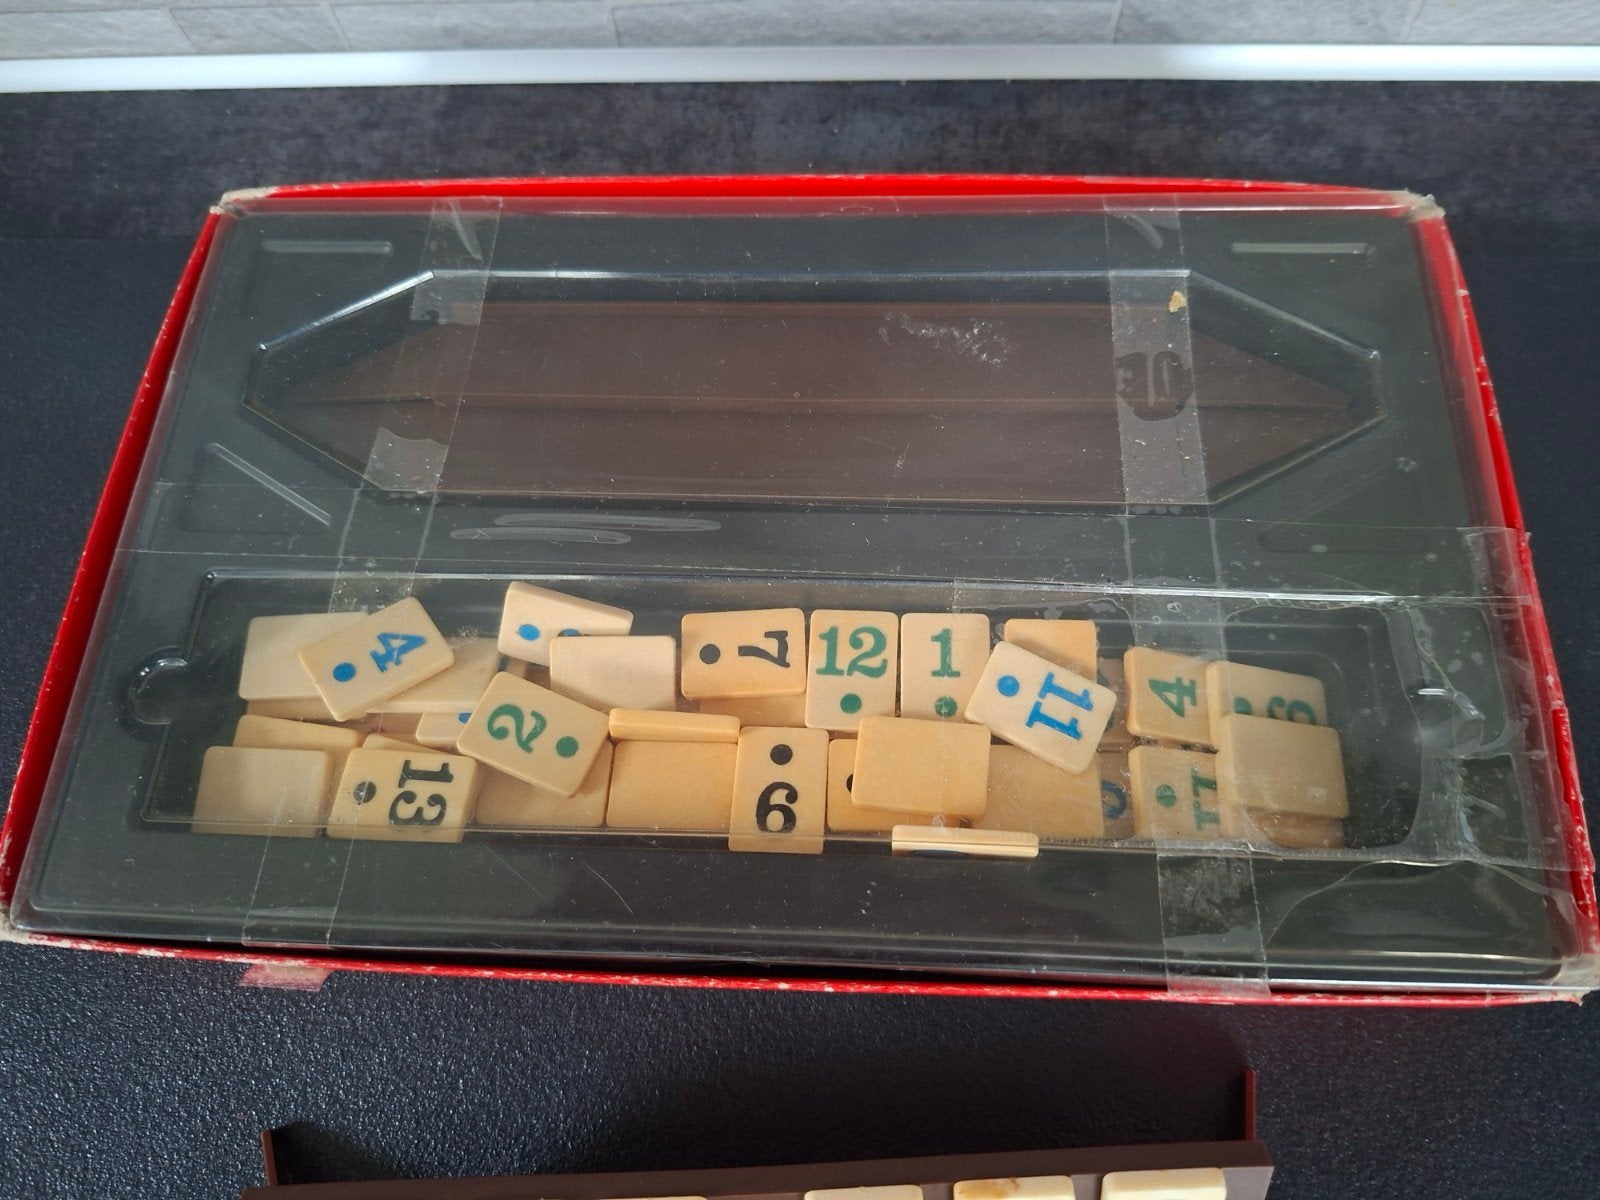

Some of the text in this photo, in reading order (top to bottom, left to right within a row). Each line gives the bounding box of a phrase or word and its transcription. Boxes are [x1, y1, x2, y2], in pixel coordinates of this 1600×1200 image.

[369, 631, 428, 673] 4
[737, 629, 791, 669] 7
[815, 625, 889, 679] 12
[930, 627, 961, 678] 1
[1025, 671, 1095, 741] 11
[1148, 676, 1197, 719] 4
[487, 703, 547, 754] 2
[388, 758, 455, 827] 13
